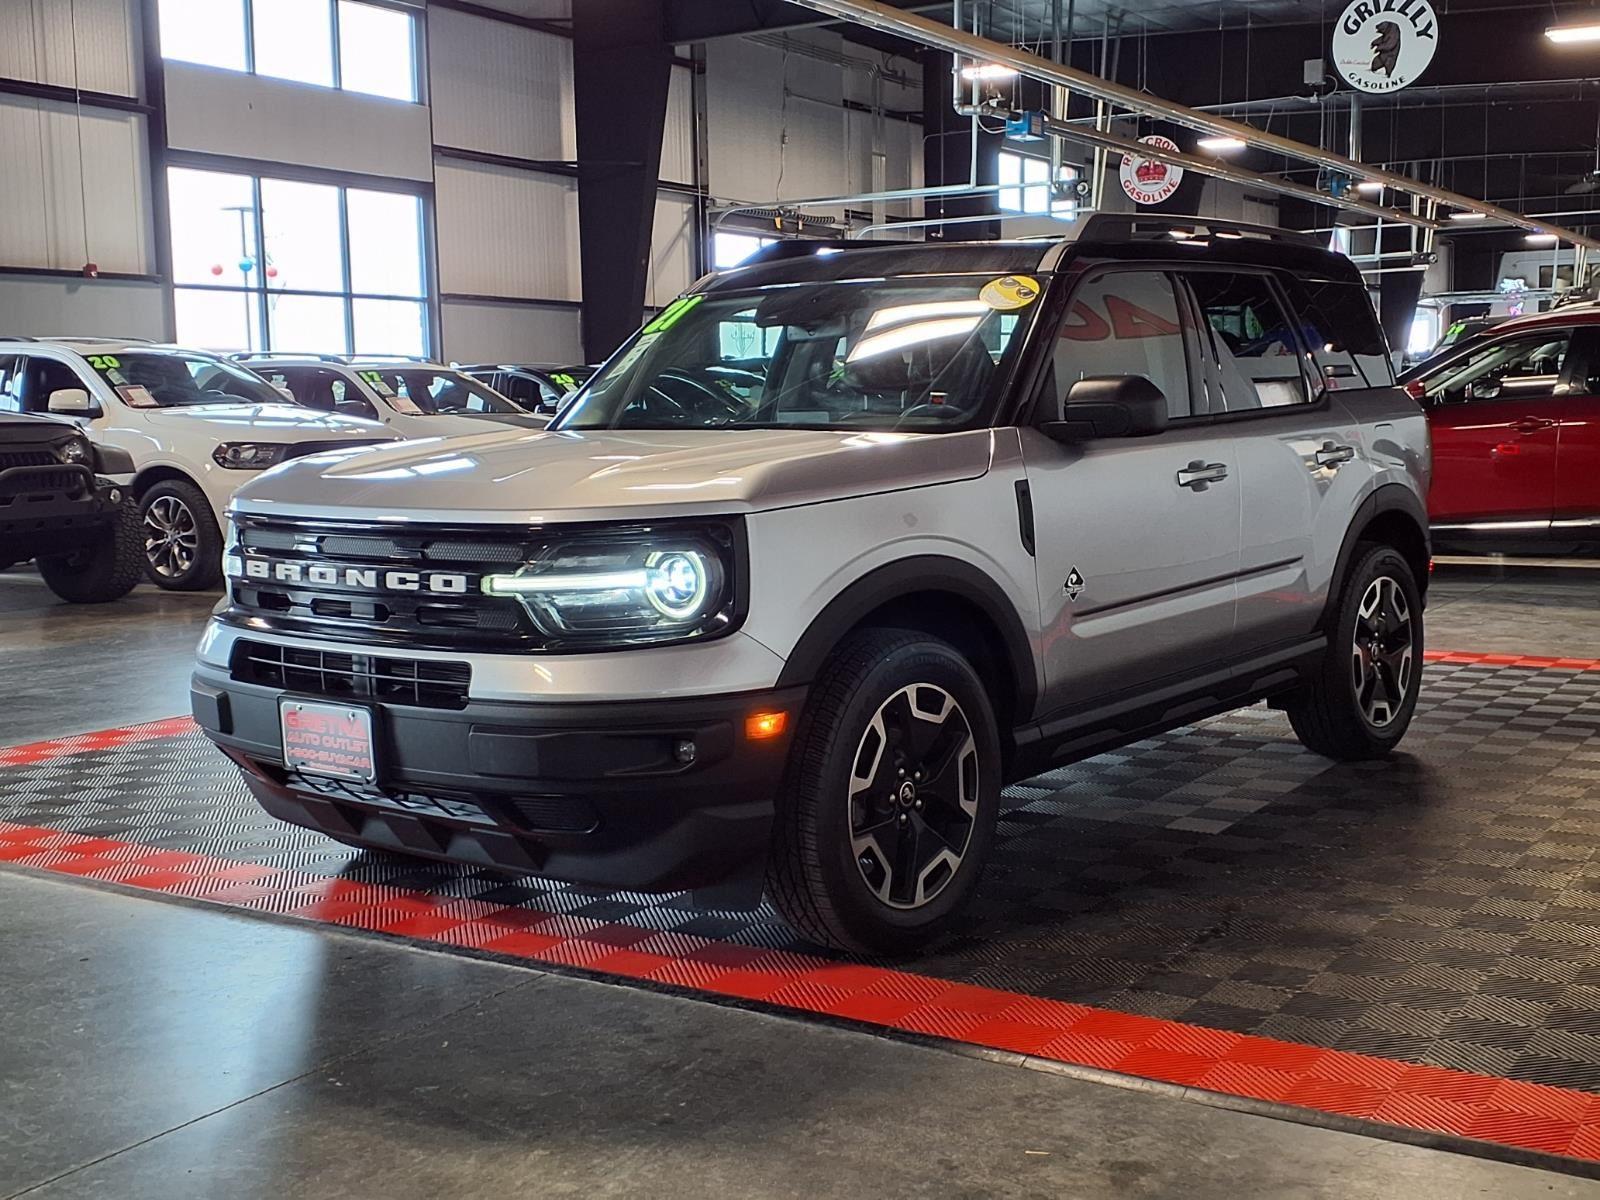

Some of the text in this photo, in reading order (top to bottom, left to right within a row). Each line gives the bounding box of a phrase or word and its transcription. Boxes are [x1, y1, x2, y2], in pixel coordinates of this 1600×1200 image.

[1343, 0, 1434, 39] GRIZZLY
[1348, 72, 1407, 89] GASOLINE
[1123, 178, 1178, 202] GASOLINE
[87, 355, 121, 369] 20
[246, 560, 467, 593] BRONCO
[287, 730, 369, 753] AUTO OUTLET
